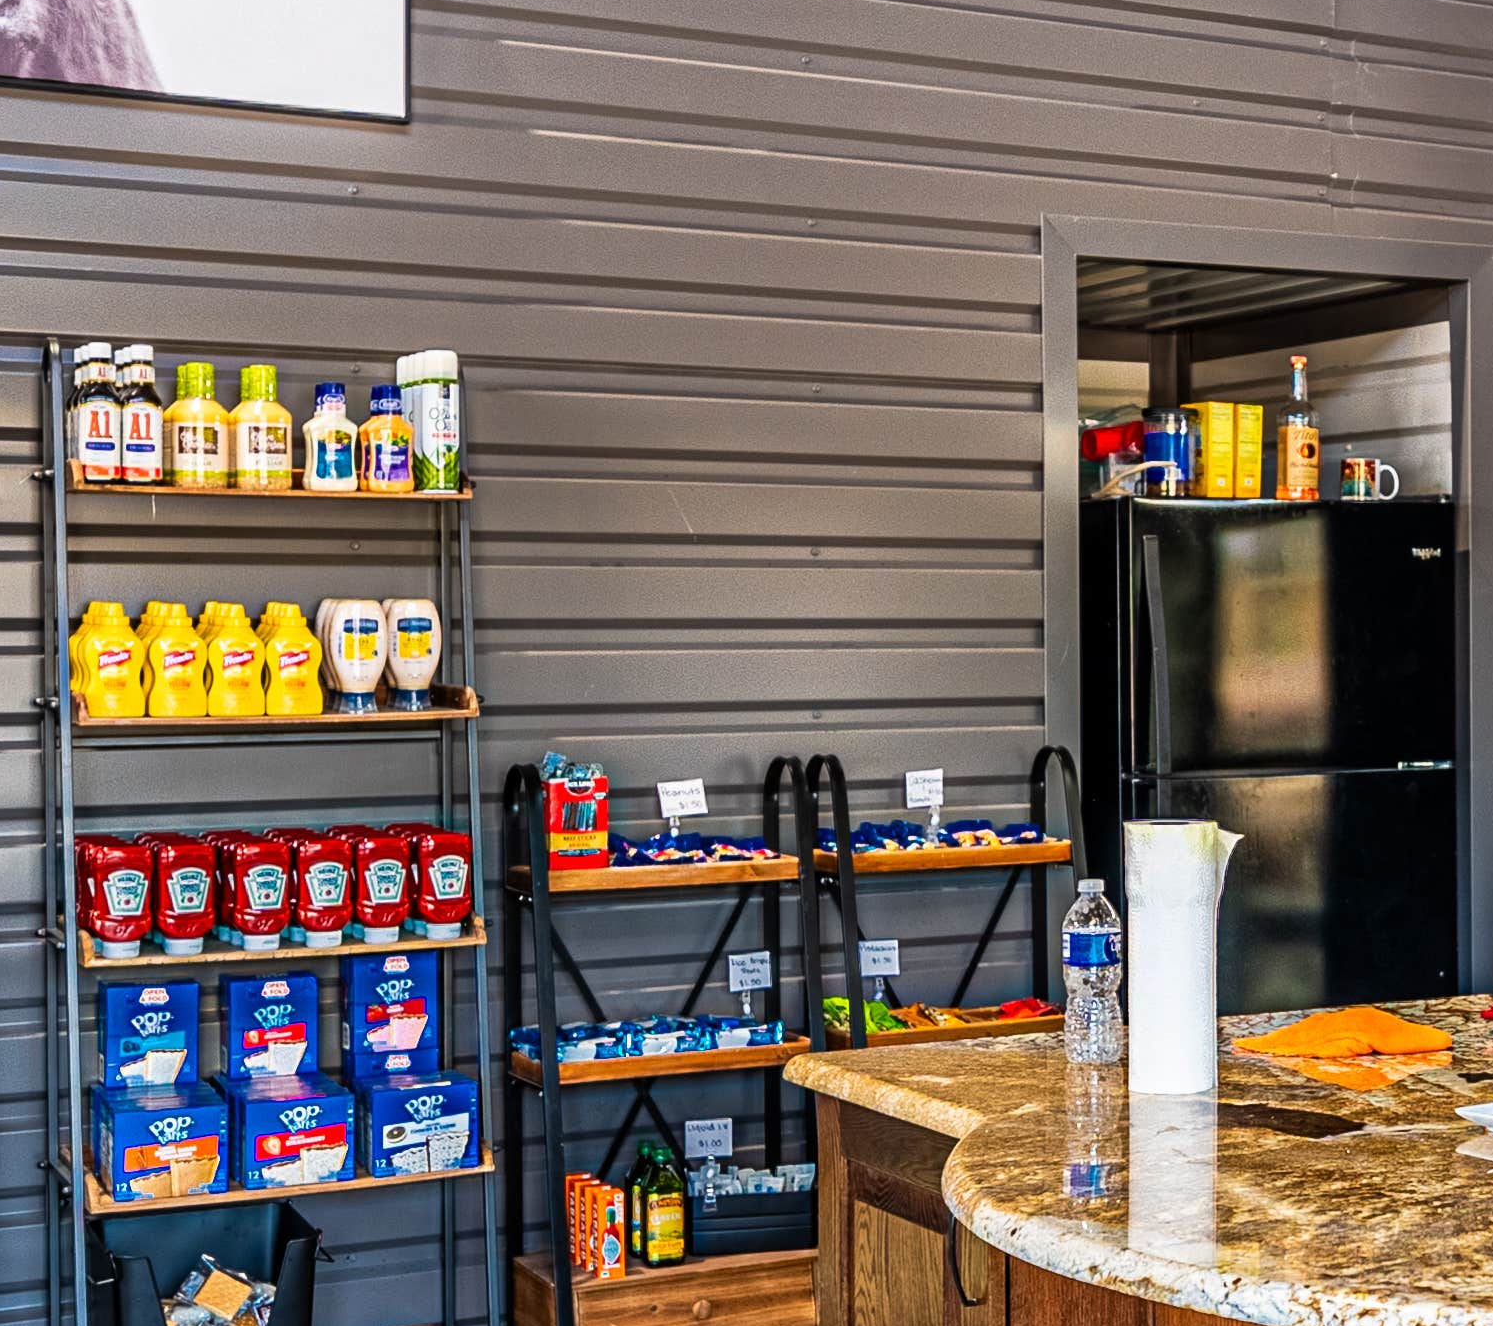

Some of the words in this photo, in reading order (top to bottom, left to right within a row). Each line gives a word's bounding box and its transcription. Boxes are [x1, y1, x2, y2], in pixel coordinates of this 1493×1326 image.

[375, 1159, 386, 1168] 12
[248, 1171, 259, 1179] 12
[116, 1183, 128, 1192] 12
